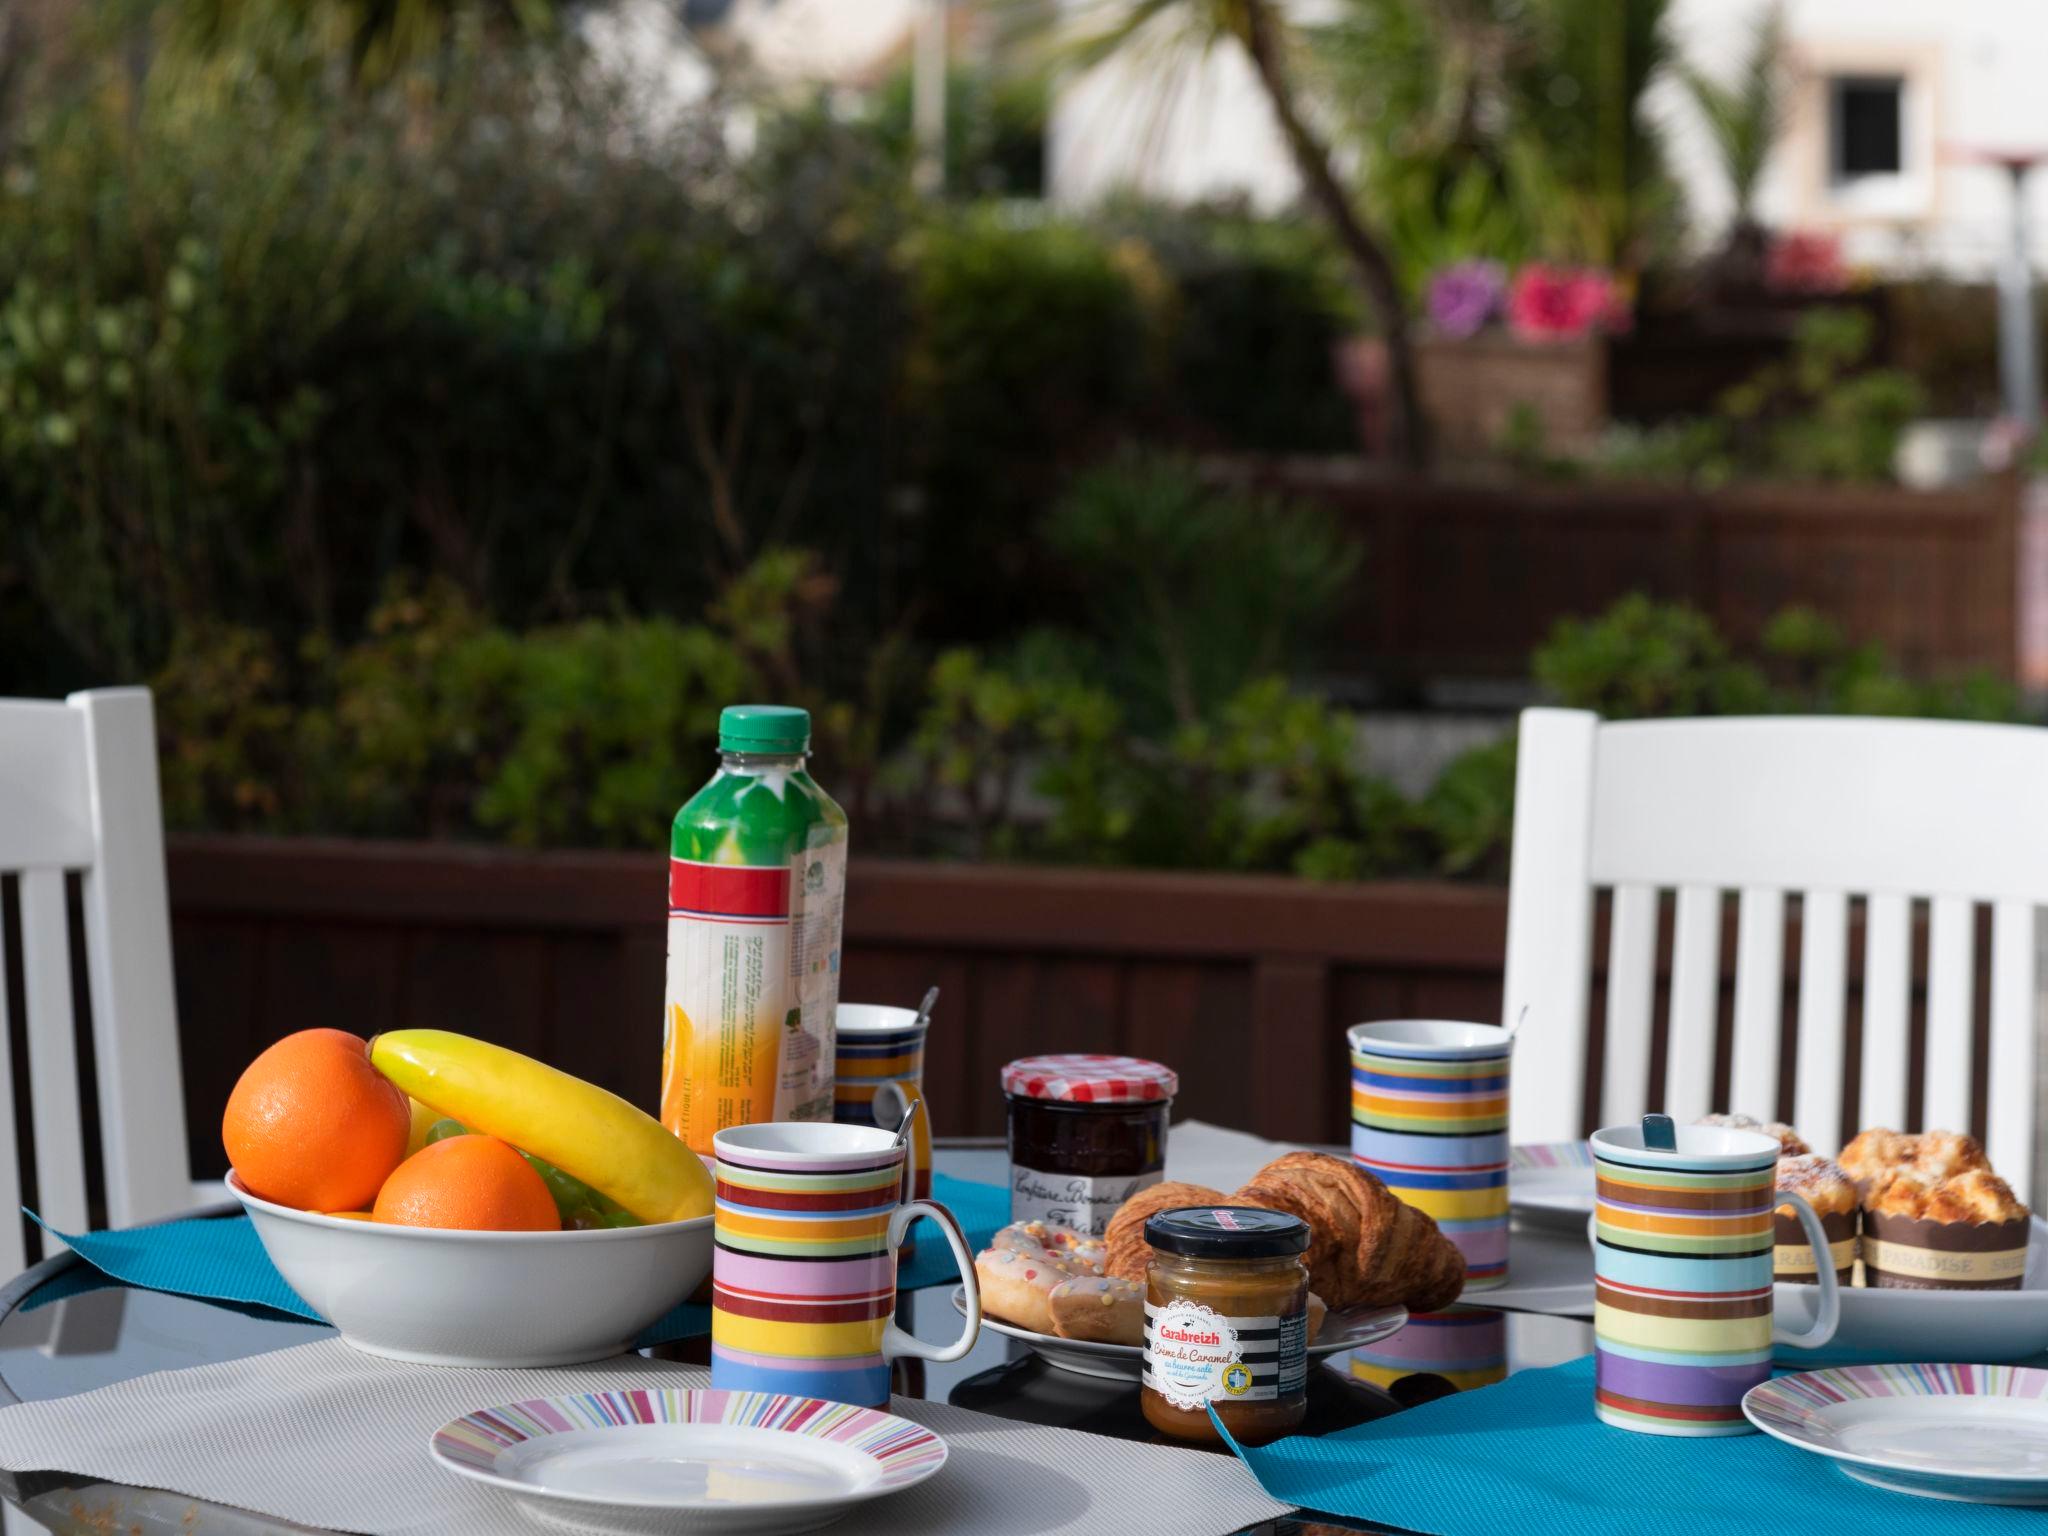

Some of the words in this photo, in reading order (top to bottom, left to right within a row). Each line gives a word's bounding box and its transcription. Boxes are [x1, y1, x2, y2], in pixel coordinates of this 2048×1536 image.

[1882, 1247, 1973, 1273] PARADISE
[1160, 1325, 1220, 1345] Carabreizh
[1154, 1342, 1176, 1357] Crème
[1177, 1346, 1188, 1360] de
[1189, 1349, 1233, 1364] Caramel
